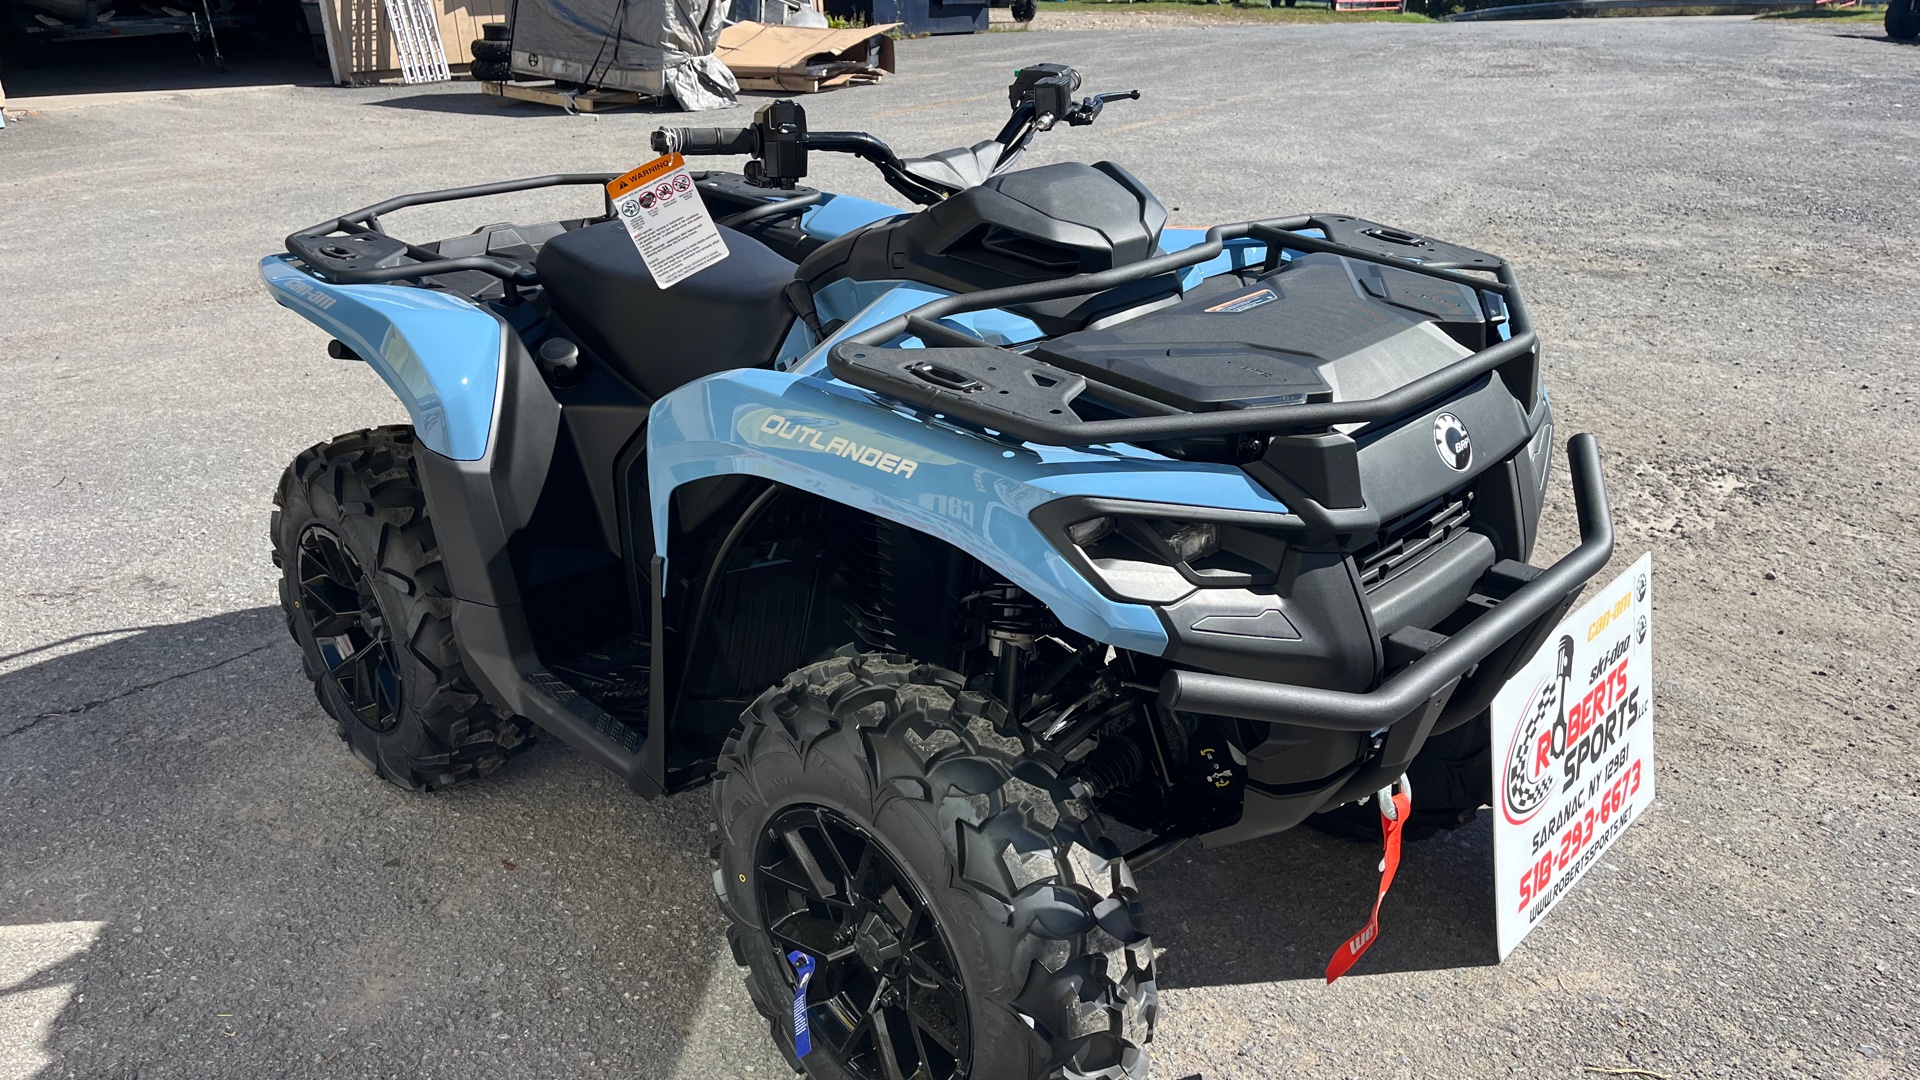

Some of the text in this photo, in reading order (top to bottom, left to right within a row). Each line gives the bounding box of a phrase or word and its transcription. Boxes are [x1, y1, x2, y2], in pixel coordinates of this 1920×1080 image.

[628, 159, 670, 183] WARNING
[283, 280, 337, 310] can-am
[760, 414, 918, 479] OUTLANDER
[1455, 437, 1469, 453] BRP
[1587, 591, 1632, 643] can-am
[1588, 634, 1631, 685] ski-doo
[1534, 656, 1629, 779] ROBERTS
[1562, 685, 1640, 795] SPORTS
[1588, 768, 1602, 799] NY
[1604, 742, 1629, 784] 12981
[1517, 758, 1642, 914] 518-293-6673
